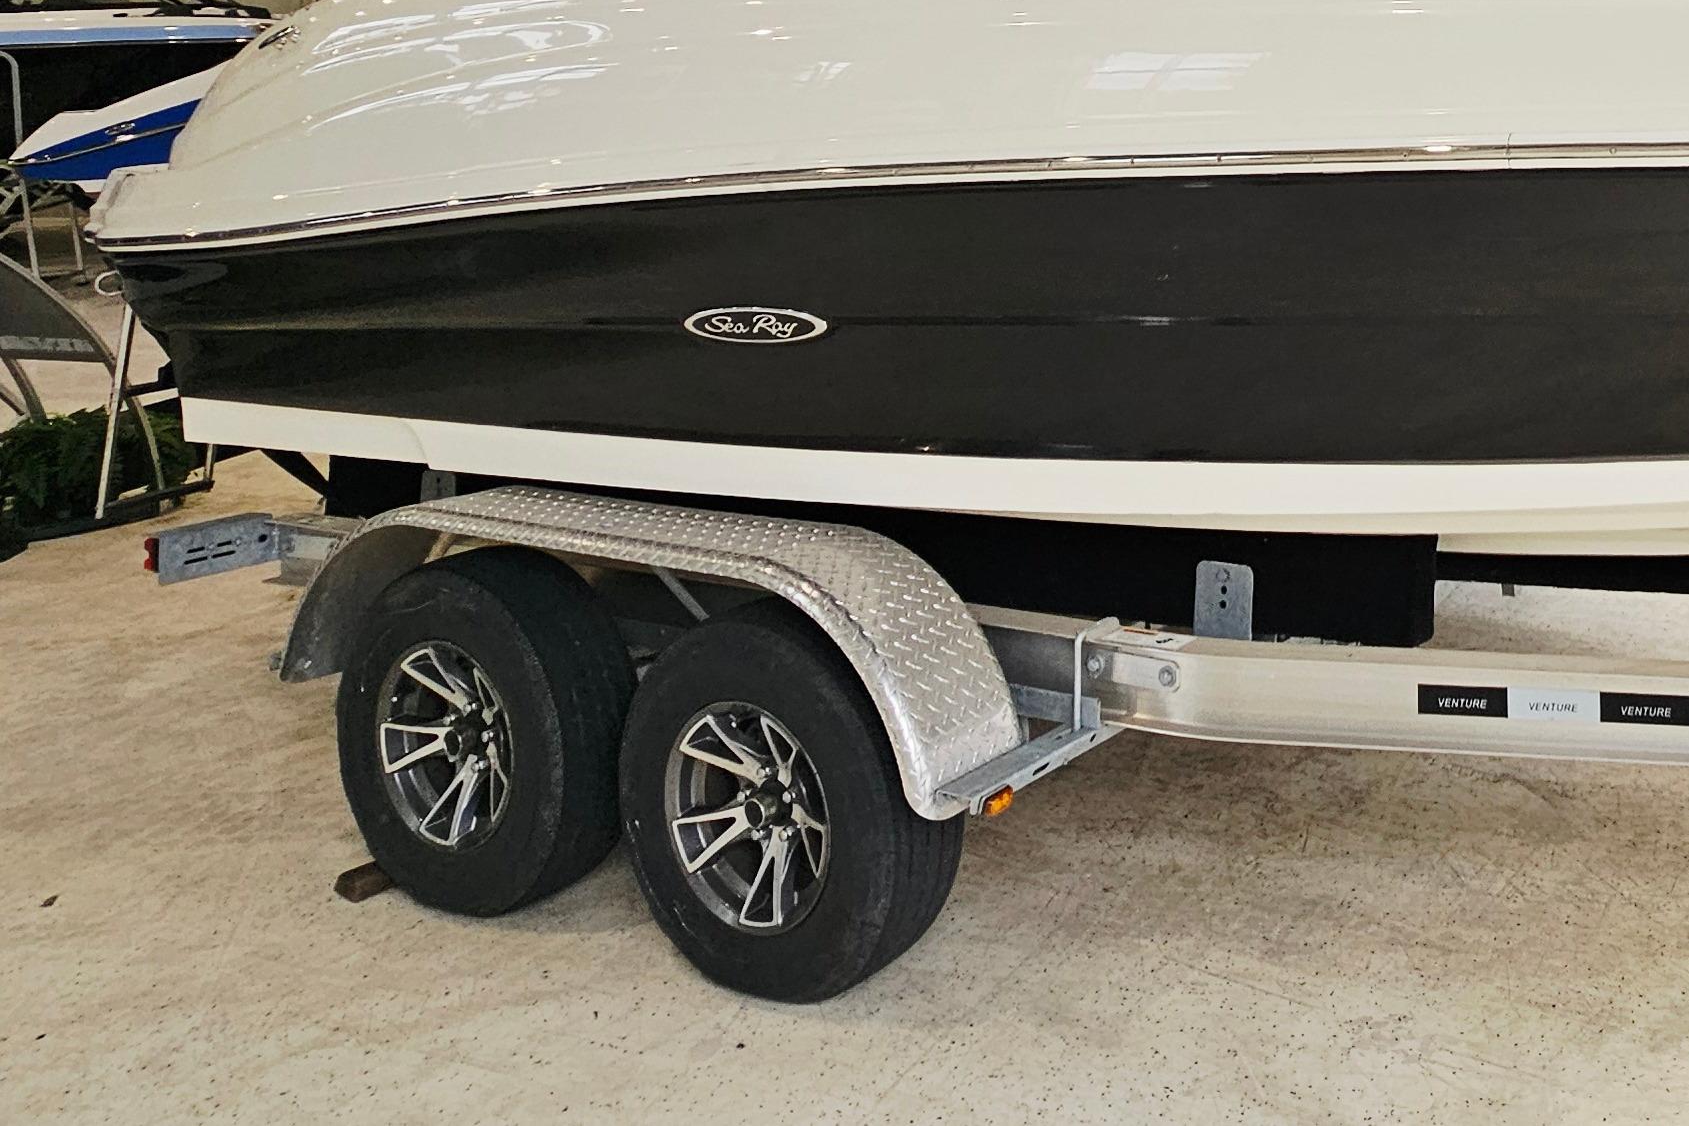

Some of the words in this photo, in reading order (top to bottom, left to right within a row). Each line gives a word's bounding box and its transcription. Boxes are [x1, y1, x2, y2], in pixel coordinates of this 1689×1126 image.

[704, 315, 750, 334] Sea
[752, 313, 799, 339] Ray
[1437, 696, 1488, 710] VENTURE
[1528, 701, 1579, 713] VENTURE
[1620, 704, 1672, 719] VENTURE
